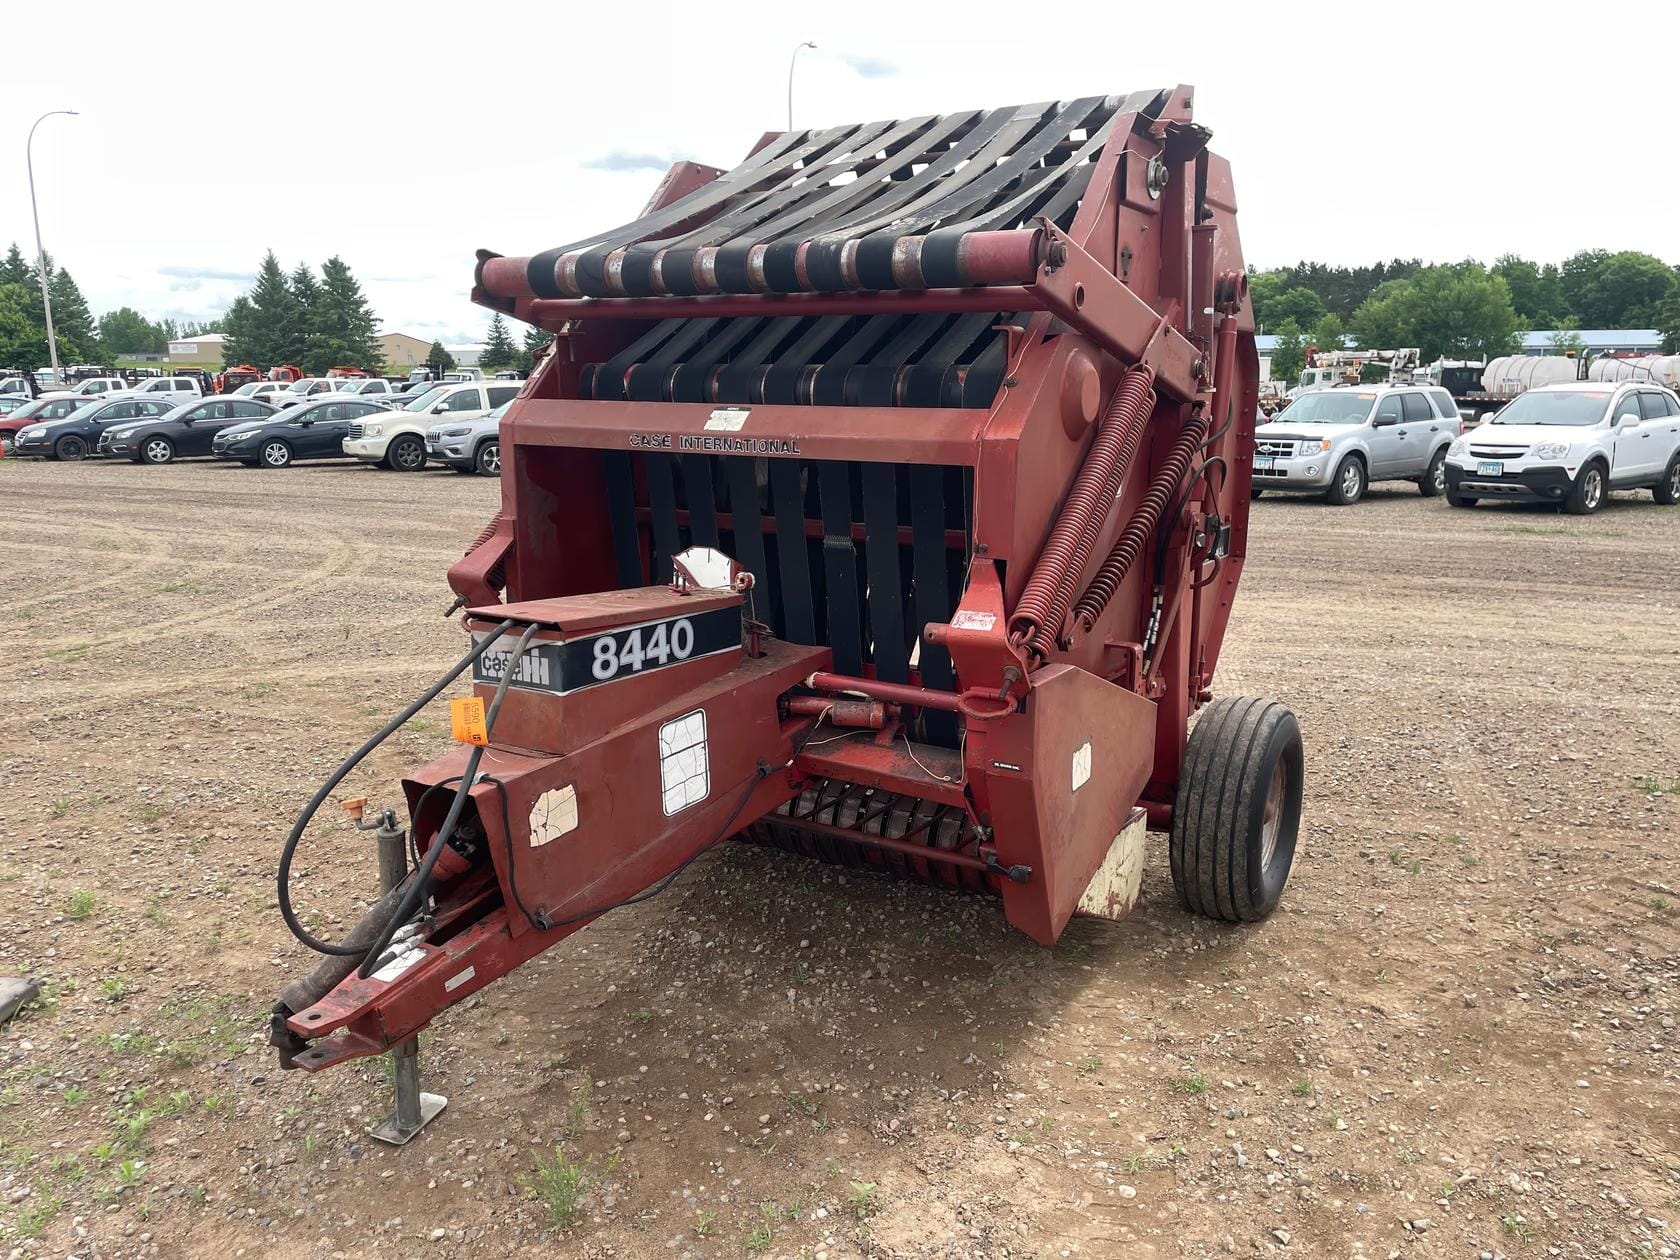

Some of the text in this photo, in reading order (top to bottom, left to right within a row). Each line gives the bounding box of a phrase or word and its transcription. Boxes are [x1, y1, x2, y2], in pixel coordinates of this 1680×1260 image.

[629, 433, 801, 454] CASE INTERNATIONAL
[592, 618, 694, 680] 8440
